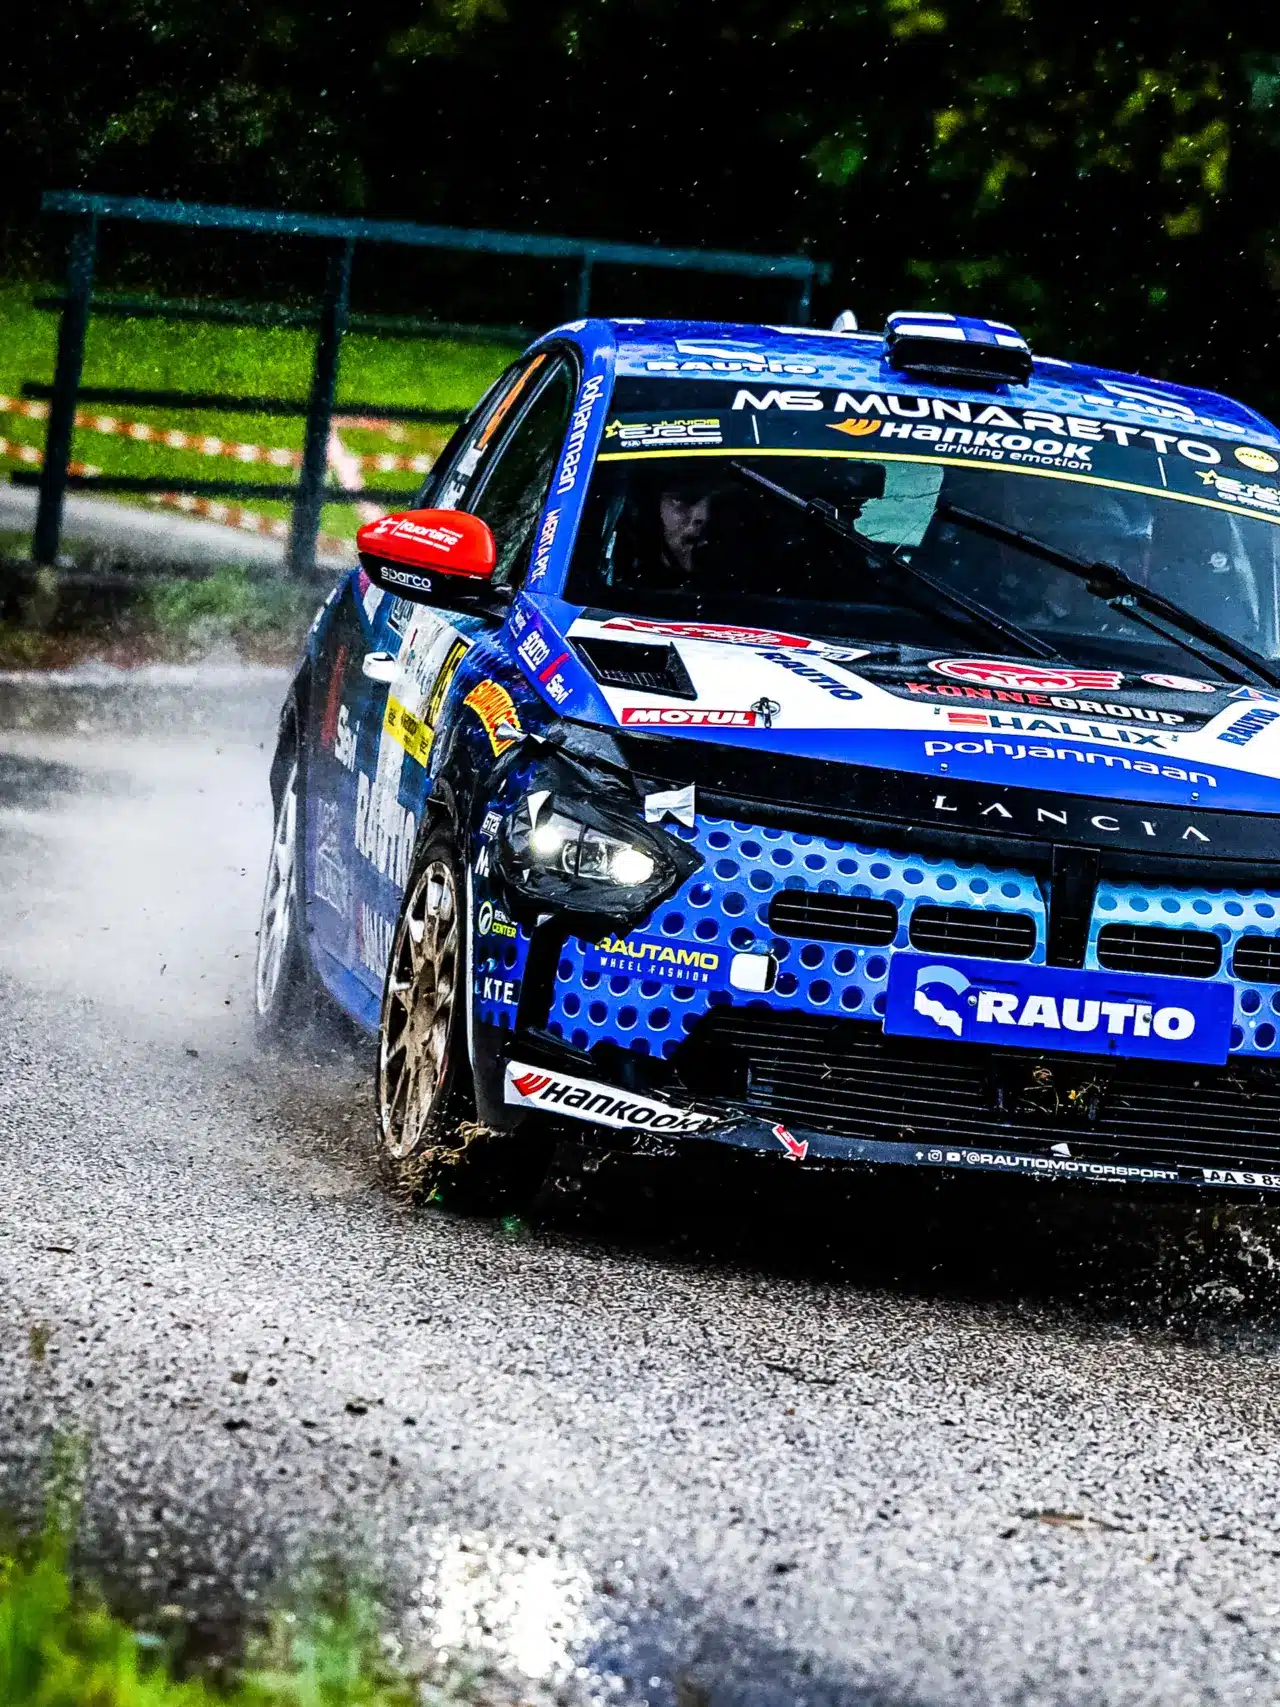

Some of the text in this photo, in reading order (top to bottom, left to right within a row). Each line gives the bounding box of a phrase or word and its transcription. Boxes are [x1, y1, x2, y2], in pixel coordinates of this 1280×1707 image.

[834, 392, 1222, 464] MUNARETTO
[880, 421, 1093, 463] Hankook
[934, 443, 1093, 472] driving emotion
[380, 566, 432, 590] sparco
[755, 651, 863, 701] RAUTIO
[625, 710, 751, 725] MOTUL
[905, 682, 1185, 726] KONNEGROUP
[988, 715, 1168, 749] HALLIX
[924, 739, 1217, 788] pohjanmaan
[934, 794, 1210, 842] LANCIA
[492, 922, 517, 938] CENTER
[595, 936, 719, 970] RAUTAMO
[600, 956, 708, 983] WHEEL FASHION
[483, 976, 514, 1005] KTE
[976, 990, 1196, 1040] RAUTIO
[966, 1151, 1178, 1181] @RAUTIOMOTORSPORT
[1210, 1170, 1236, 1183] AA
[1243, 1172, 1256, 1184] S
